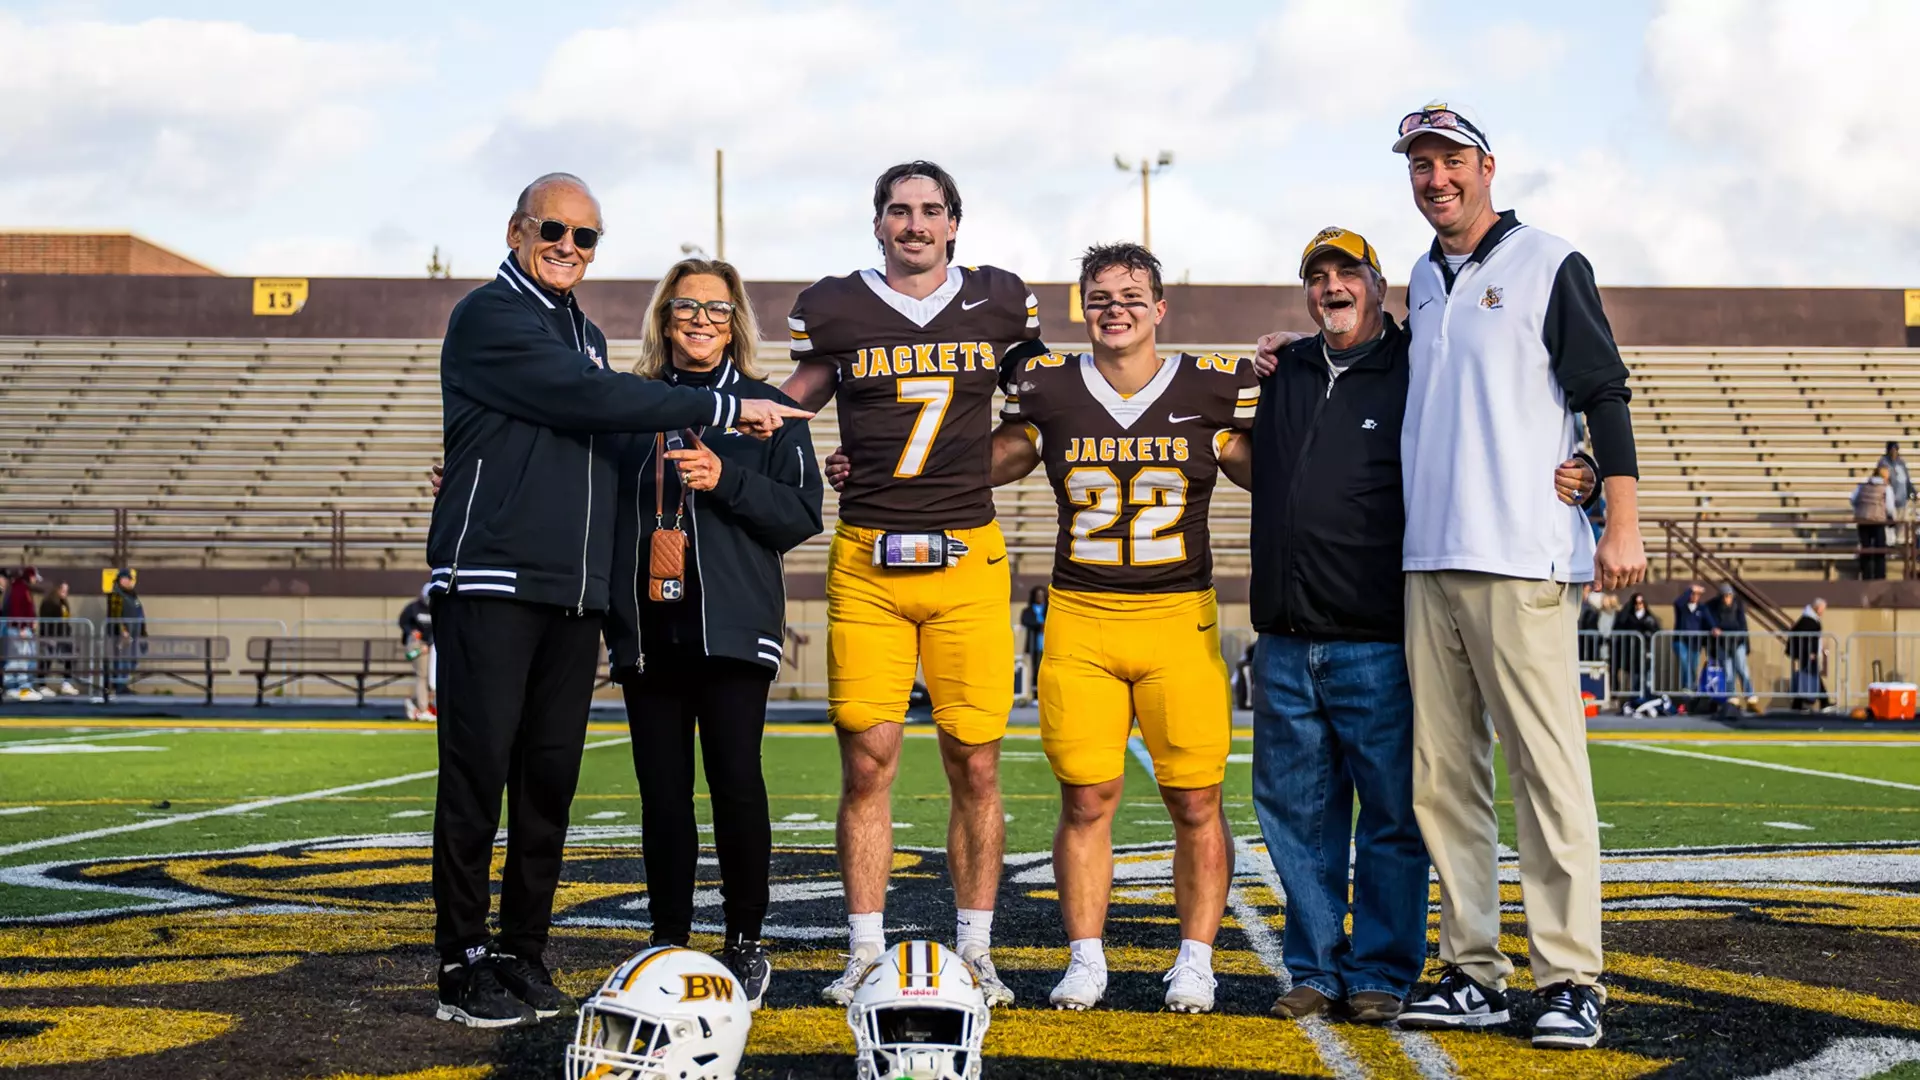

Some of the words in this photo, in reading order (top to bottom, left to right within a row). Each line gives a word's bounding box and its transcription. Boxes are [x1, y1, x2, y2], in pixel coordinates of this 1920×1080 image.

[269, 291, 293, 308] 13
[851, 342, 996, 379] JACKETS
[893, 376, 955, 479] 7
[1065, 437, 1189, 463] JACKETS
[1063, 466, 1189, 566] 22
[678, 972, 734, 1004] BW
[902, 988, 939, 997] Riddell
